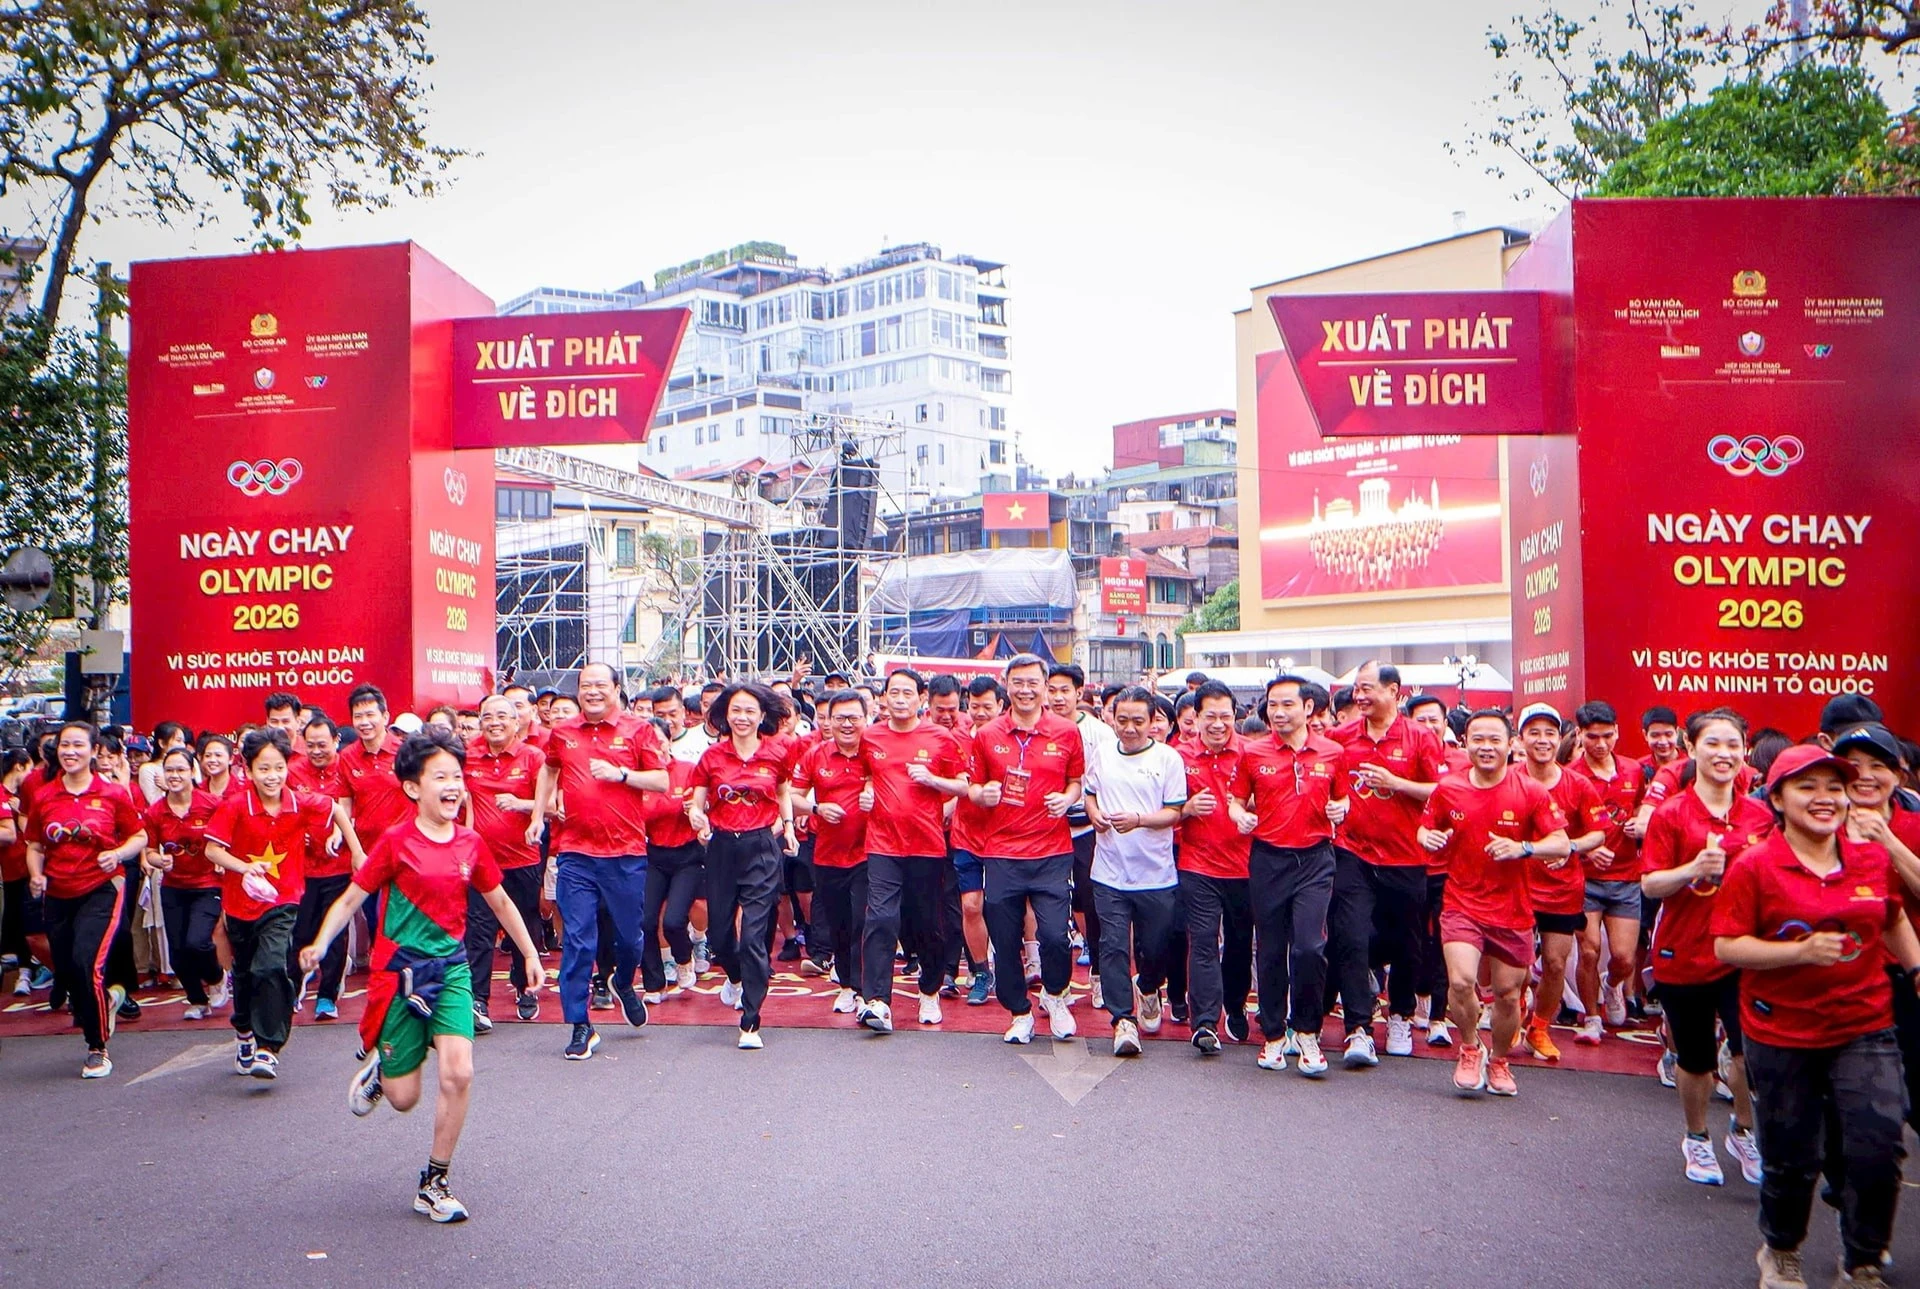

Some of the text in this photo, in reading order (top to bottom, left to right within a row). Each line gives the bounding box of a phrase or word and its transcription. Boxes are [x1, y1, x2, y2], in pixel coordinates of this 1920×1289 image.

[1630, 309, 1652, 318] THAO
[1654, 308, 1666, 318] VÀ
[1668, 309, 1679, 318] DU
[1681, 309, 1700, 319] LỊCH
[1737, 299, 1764, 308] CÔNG
[1766, 299, 1779, 308] AN
[1804, 308, 1884, 318] THÀNH PHỐ HÀ NỘI
[1818, 299, 1835, 307] BAN
[1837, 297, 1862, 307] NHÂN
[1864, 297, 1883, 307] DÂN
[254, 338, 275, 347] CÔNG
[276, 337, 287, 346] AN
[317, 335, 331, 343] BAN
[332, 333, 351, 342] NHÂN
[352, 331, 368, 340] DÂN
[1321, 312, 1513, 352] XUẤT PHÁT
[171, 353, 188, 361] THAO
[200, 352, 209, 360] DU
[476, 330, 642, 370] XUẤT PHÁT
[1803, 344, 1834, 359] VTV
[304, 375, 328, 389] VTV
[1350, 367, 1487, 407] VỀ ĐÍCH
[499, 383, 617, 420] VỀ ĐÍCH
[180, 525, 354, 560] NGÀY CHẠY
[1521, 520, 1564, 565] NGÀY CHẠY
[1648, 508, 1872, 550] NGÀY CHẠY
[429, 528, 482, 569] NGÀY CHẠY
[199, 563, 333, 596] OLYMPIC
[436, 567, 477, 600] OLYMPIC
[1526, 562, 1559, 601] OLYMPIC
[1674, 555, 1847, 587] OLYMPIC
[233, 602, 300, 632] 2026
[447, 606, 468, 632] 2026
[1534, 605, 1551, 636] 2026
[1719, 598, 1803, 629] 2026
[167, 645, 364, 671] VÌ SỨC KHỎE TOÀN DÂN
[1632, 648, 1888, 672] VÌ SỨC KHỎE TOÀN DÂN
[183, 665, 354, 690] VÌ AN NINH TỔ QUỐC
[1653, 669, 1874, 696] VÌ AN NINH TỔ QUỐC
